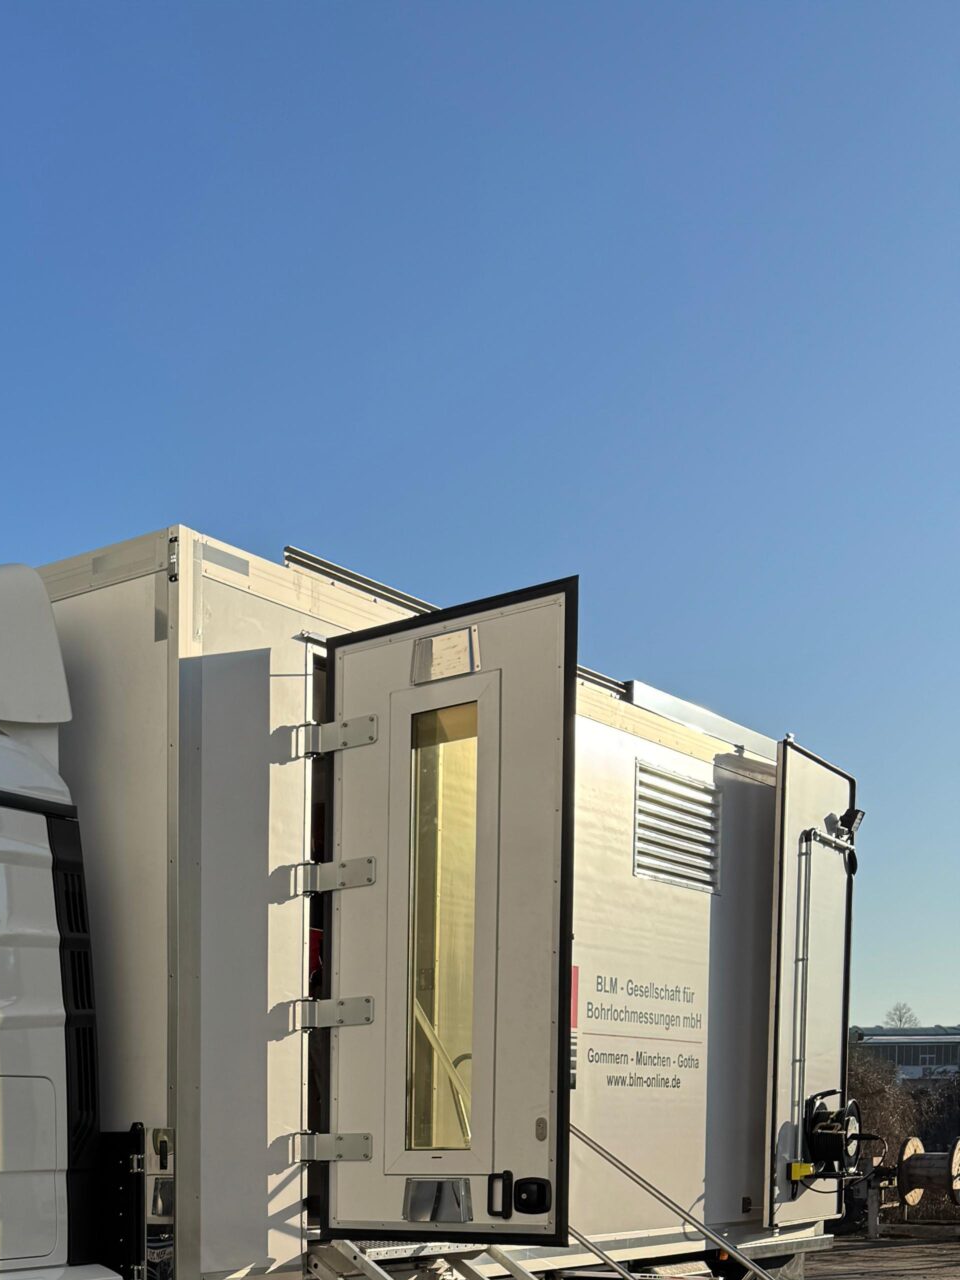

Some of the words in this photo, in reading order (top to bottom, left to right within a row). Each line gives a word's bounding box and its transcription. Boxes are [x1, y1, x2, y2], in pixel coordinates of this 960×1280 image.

[596, 975, 618, 995] BLM
[626, 979, 681, 1002] Gesellschaft
[682, 986, 695, 1004] für
[586, 1001, 681, 1030] Bohrlochmessungen
[682, 1013, 702, 1029] mbH
[587, 1048, 629, 1065] Gommern
[635, 1051, 671, 1067] München
[677, 1054, 700, 1069] Gotha
[606, 1072, 681, 1089] www.blm-online.de
